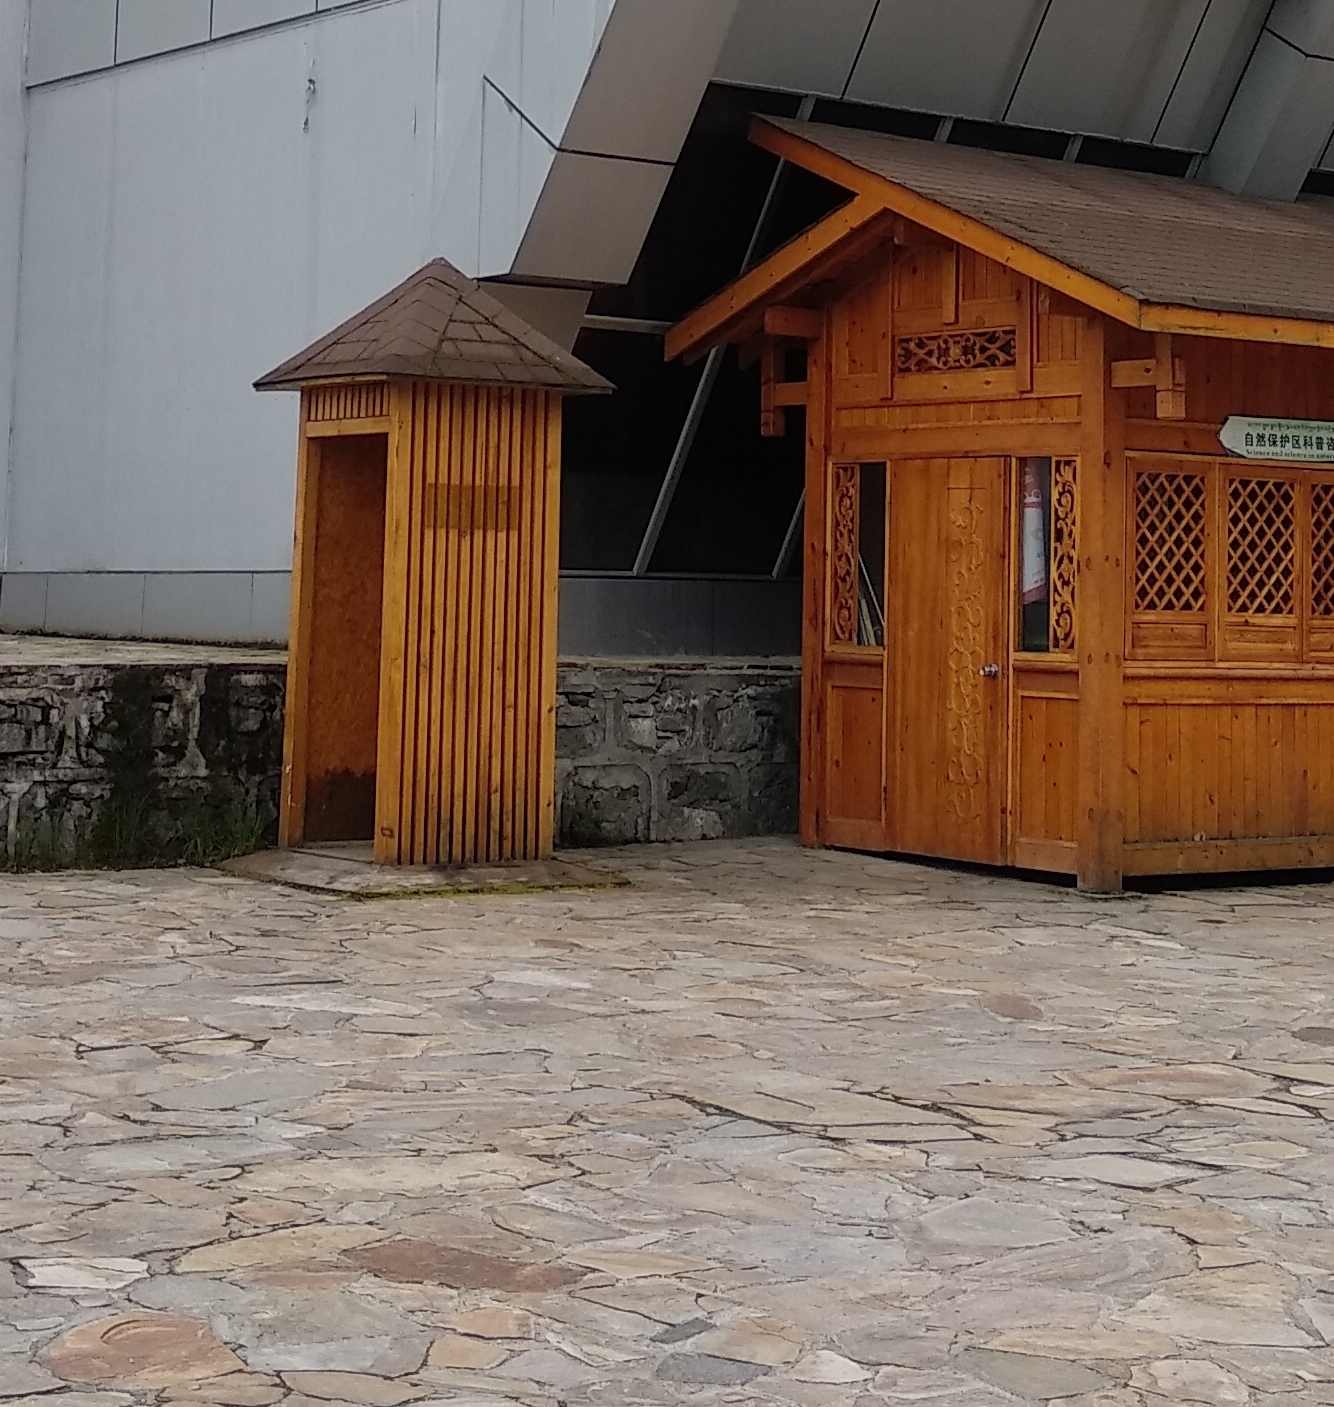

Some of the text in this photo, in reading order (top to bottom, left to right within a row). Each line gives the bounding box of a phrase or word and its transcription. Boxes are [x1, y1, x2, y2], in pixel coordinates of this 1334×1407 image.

[1245, 448, 1270, 457] Science
[1271, 450, 1283, 458] and
[1284, 451, 1307, 459] science
